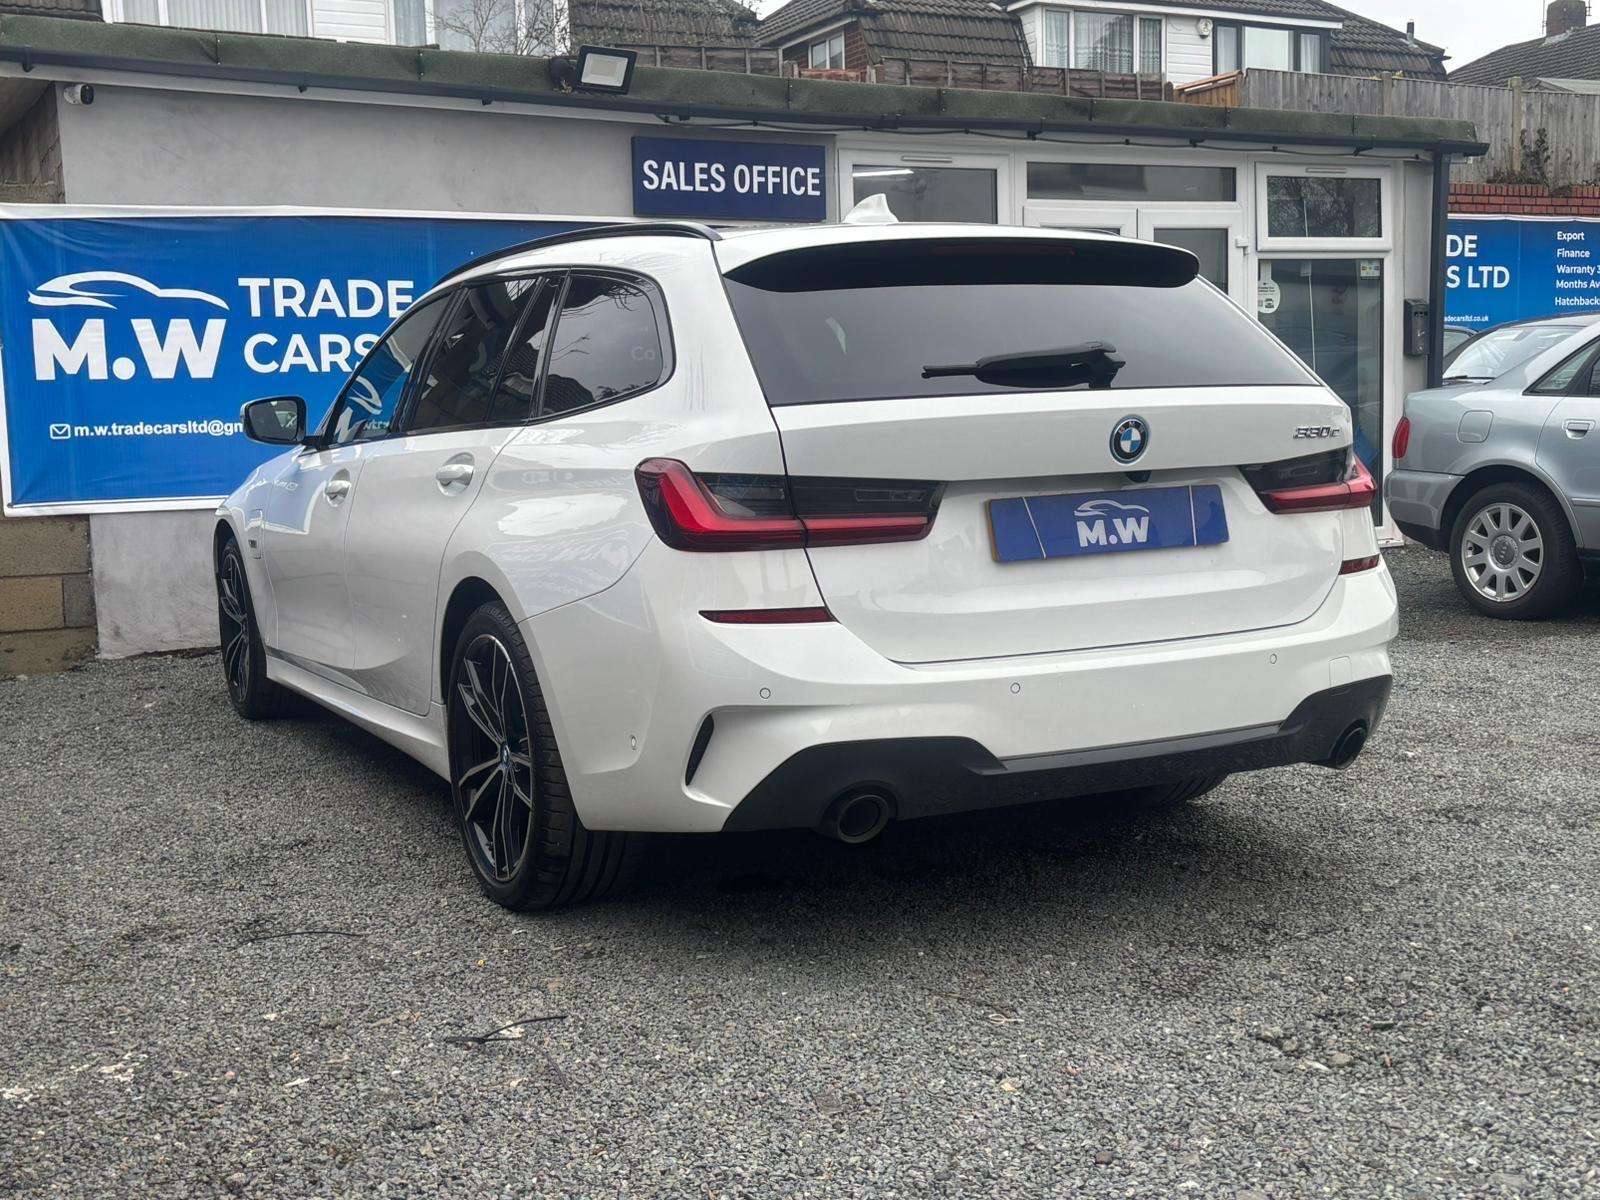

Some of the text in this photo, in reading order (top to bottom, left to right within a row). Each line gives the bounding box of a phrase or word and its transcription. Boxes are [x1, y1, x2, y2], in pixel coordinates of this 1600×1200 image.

[642, 160, 821, 197] SALES OFFICE
[1556, 231, 1585, 242] Export
[1556, 248, 1590, 258] Finance
[1467, 265, 1510, 289] LTD
[1556, 264, 1596, 276] Warranty
[1555, 279, 1588, 289] Months
[237, 277, 414, 318] TRADE
[32, 318, 227, 381] M.W
[1076, 516, 1149, 548] M.W
